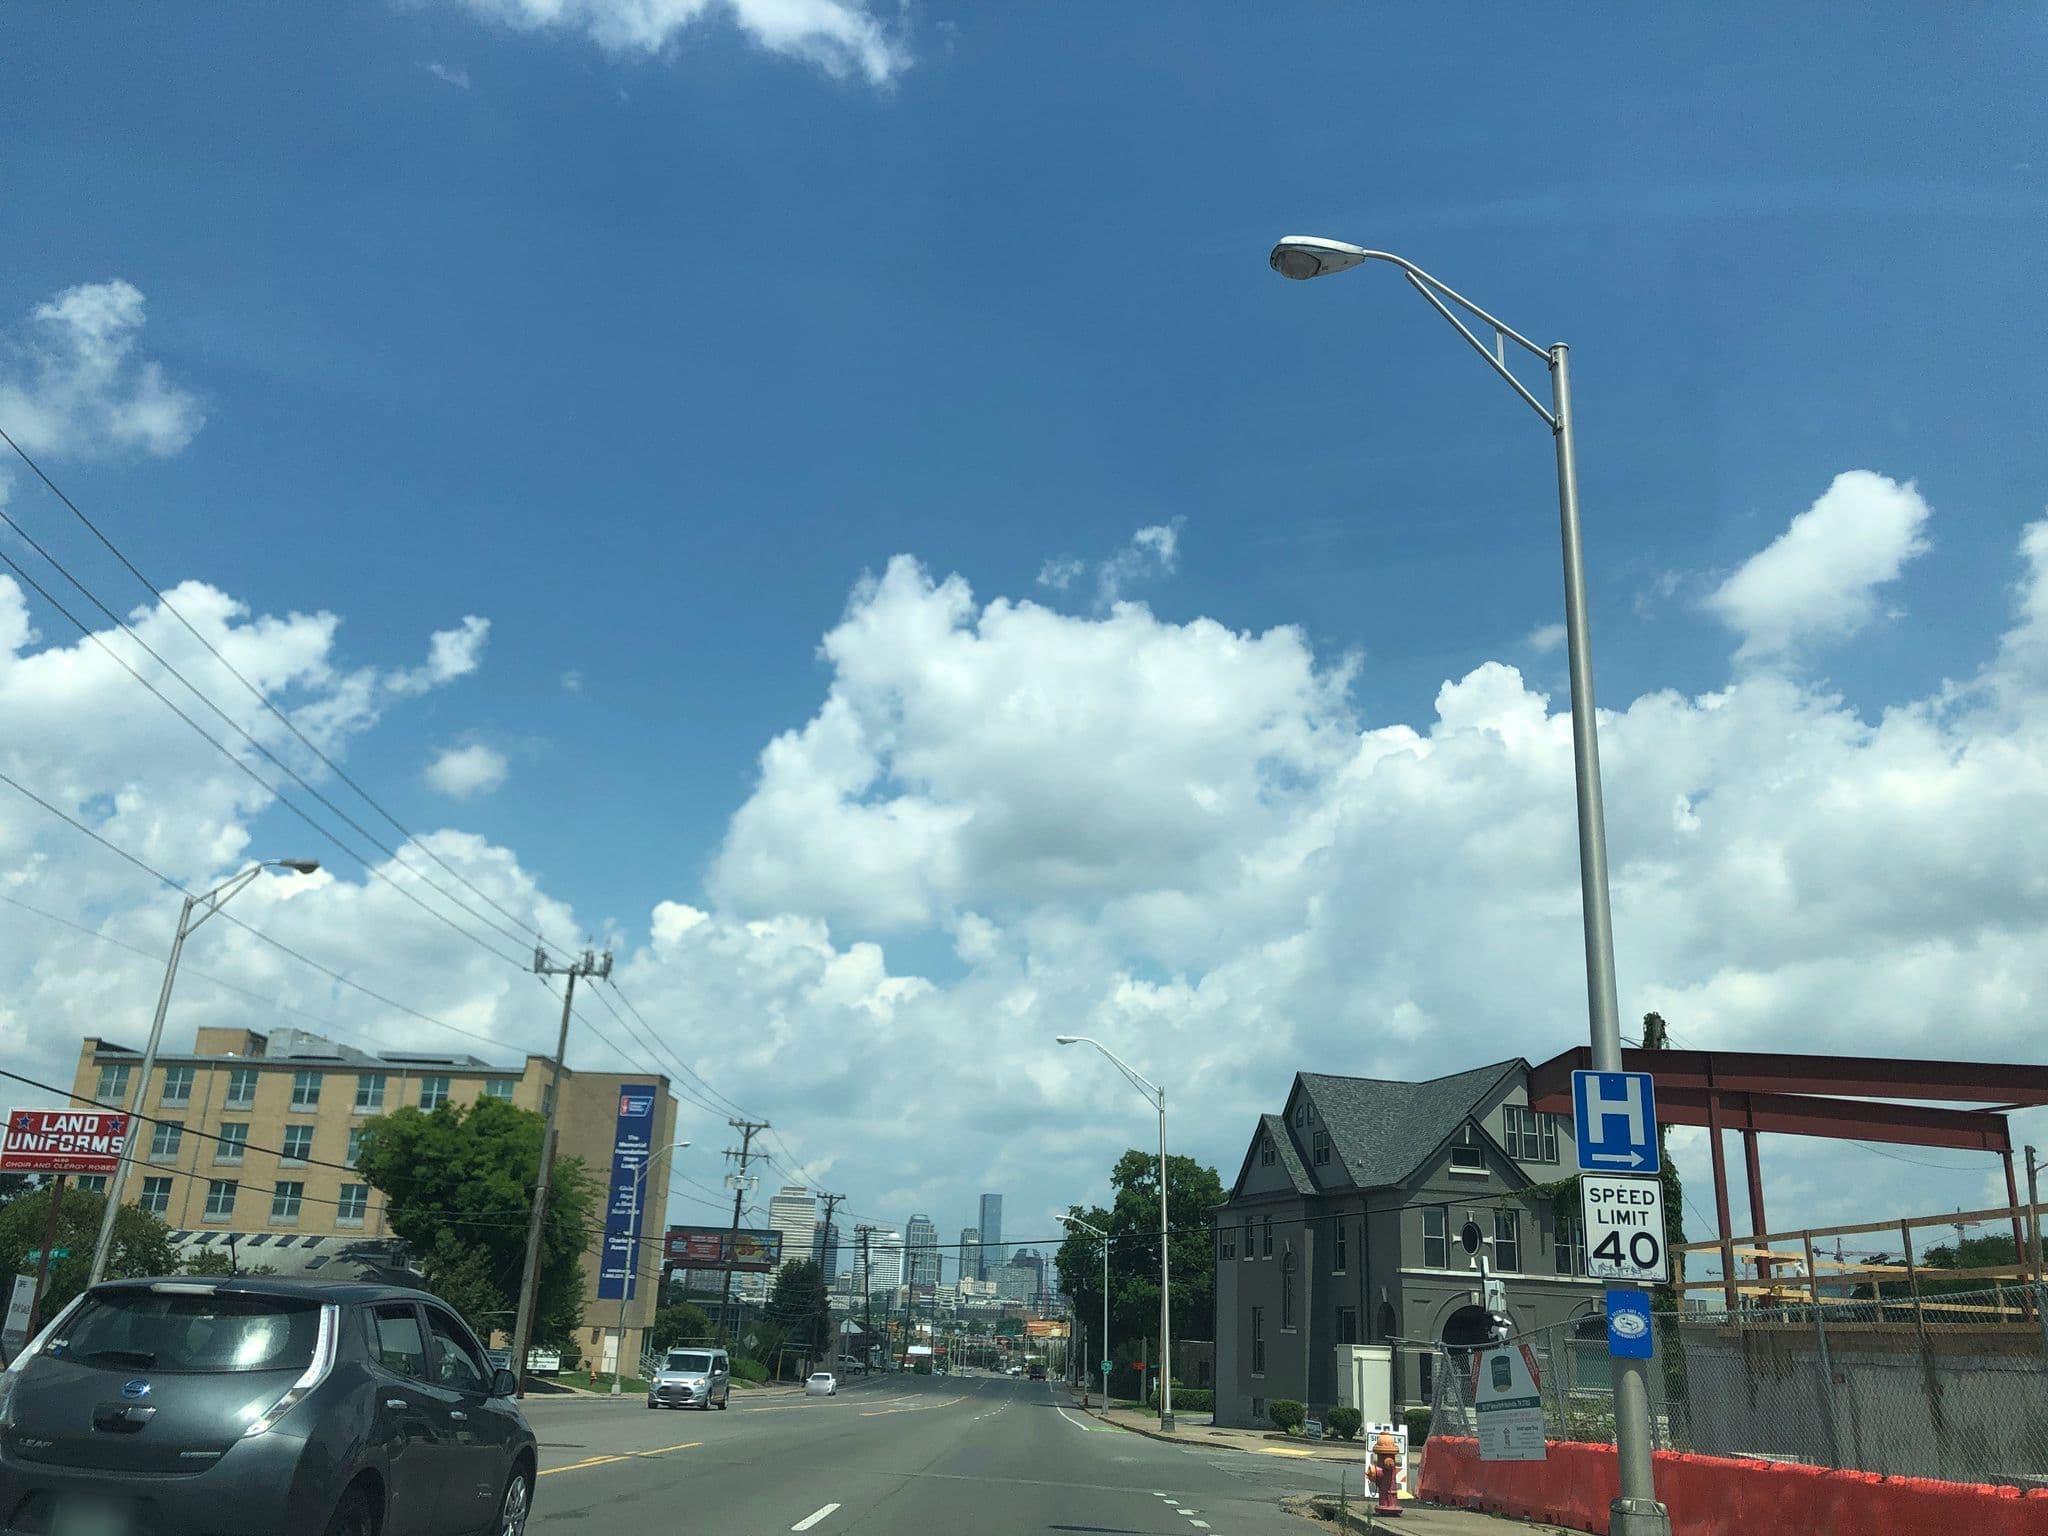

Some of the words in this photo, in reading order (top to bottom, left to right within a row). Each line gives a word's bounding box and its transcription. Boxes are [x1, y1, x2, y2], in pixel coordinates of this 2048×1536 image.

[1585, 1075, 1646, 1145] H
[41, 1114, 99, 1133] LAND
[7, 1132, 125, 1153] UNIFORMS
[1589, 1188, 1655, 1206] SPEED
[1597, 1208, 1649, 1227] LIMIT
[1593, 1230, 1660, 1270] 40
[1370, 1435, 1402, 1444] SILK
